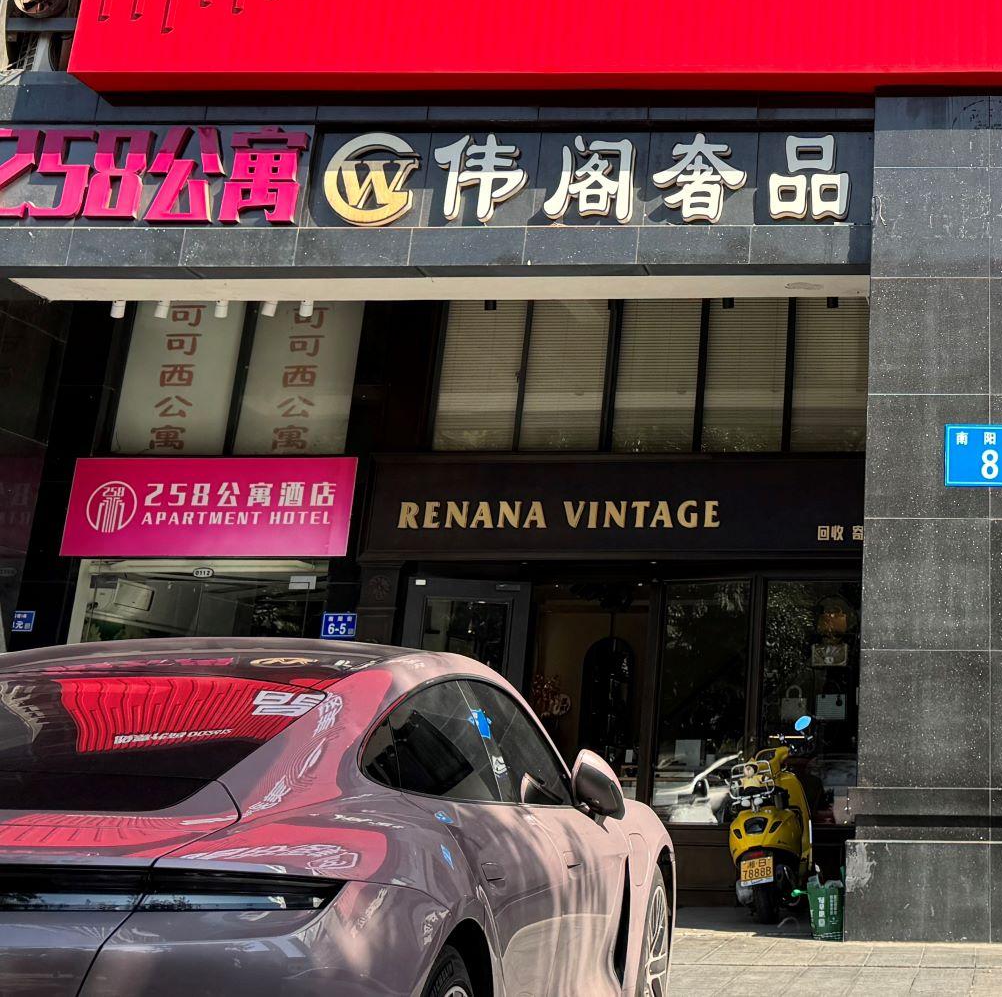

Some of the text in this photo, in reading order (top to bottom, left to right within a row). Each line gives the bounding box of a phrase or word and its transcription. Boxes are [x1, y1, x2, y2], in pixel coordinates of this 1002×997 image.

[434, 133, 849, 224] 伟阁奢品
[981, 449, 999, 479] 8
[102, 487, 125, 497] 258
[144, 482, 337, 507] 258公寓酒店
[141, 511, 331, 525] APARTMENT HOTEL
[397, 500, 721, 529] RENANA VINTAGE
[817, 525, 844, 541] 回收
[328, 623, 347, 635] 6-5
